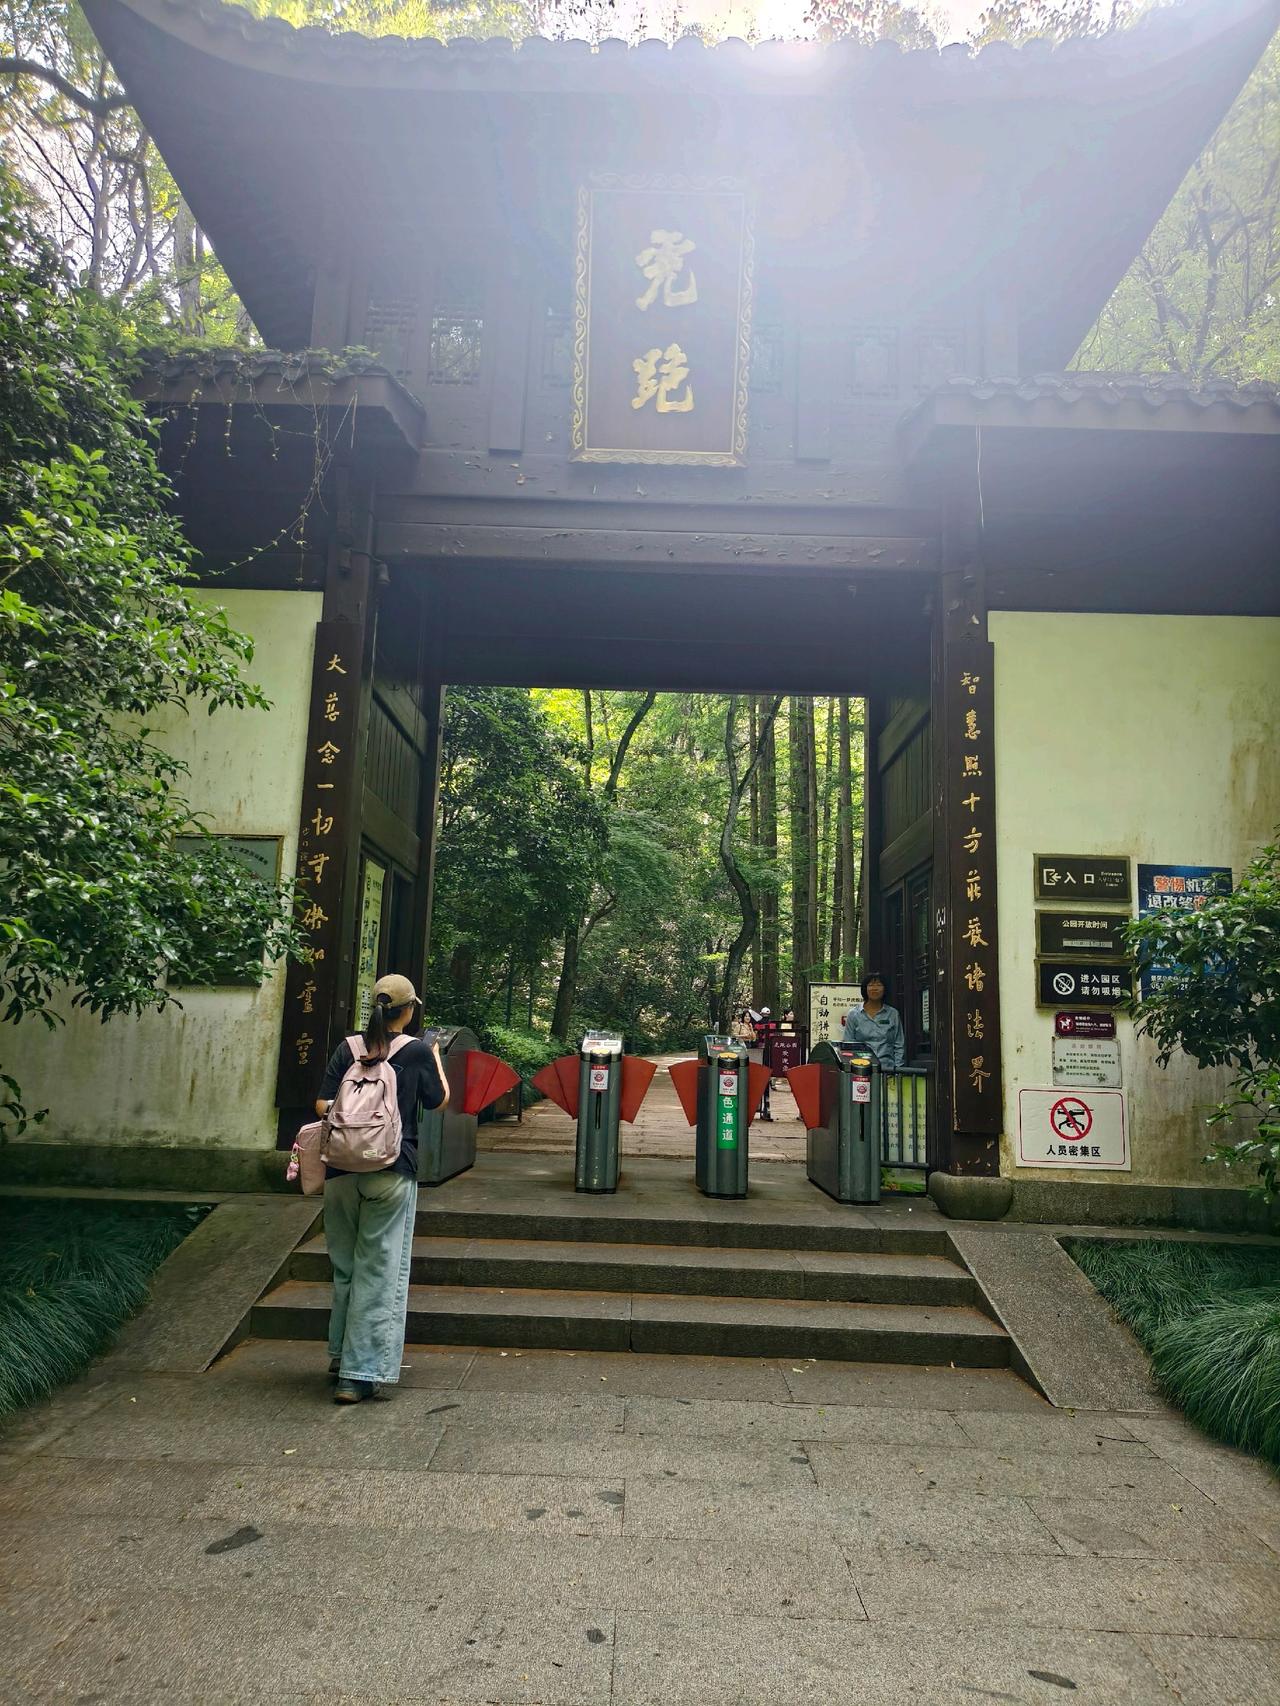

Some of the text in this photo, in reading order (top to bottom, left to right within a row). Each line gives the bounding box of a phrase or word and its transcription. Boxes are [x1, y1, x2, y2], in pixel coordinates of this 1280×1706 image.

[1063, 871, 1095, 885] 入口
[1062, 919, 1109, 929] 公园开放时间
[1080, 974, 1121, 984] 进入园区
[1080, 986, 1121, 997] 请勿吸烟
[721, 1096, 734, 1141] 色通道
[1046, 1144, 1101, 1157] 人员密集区
